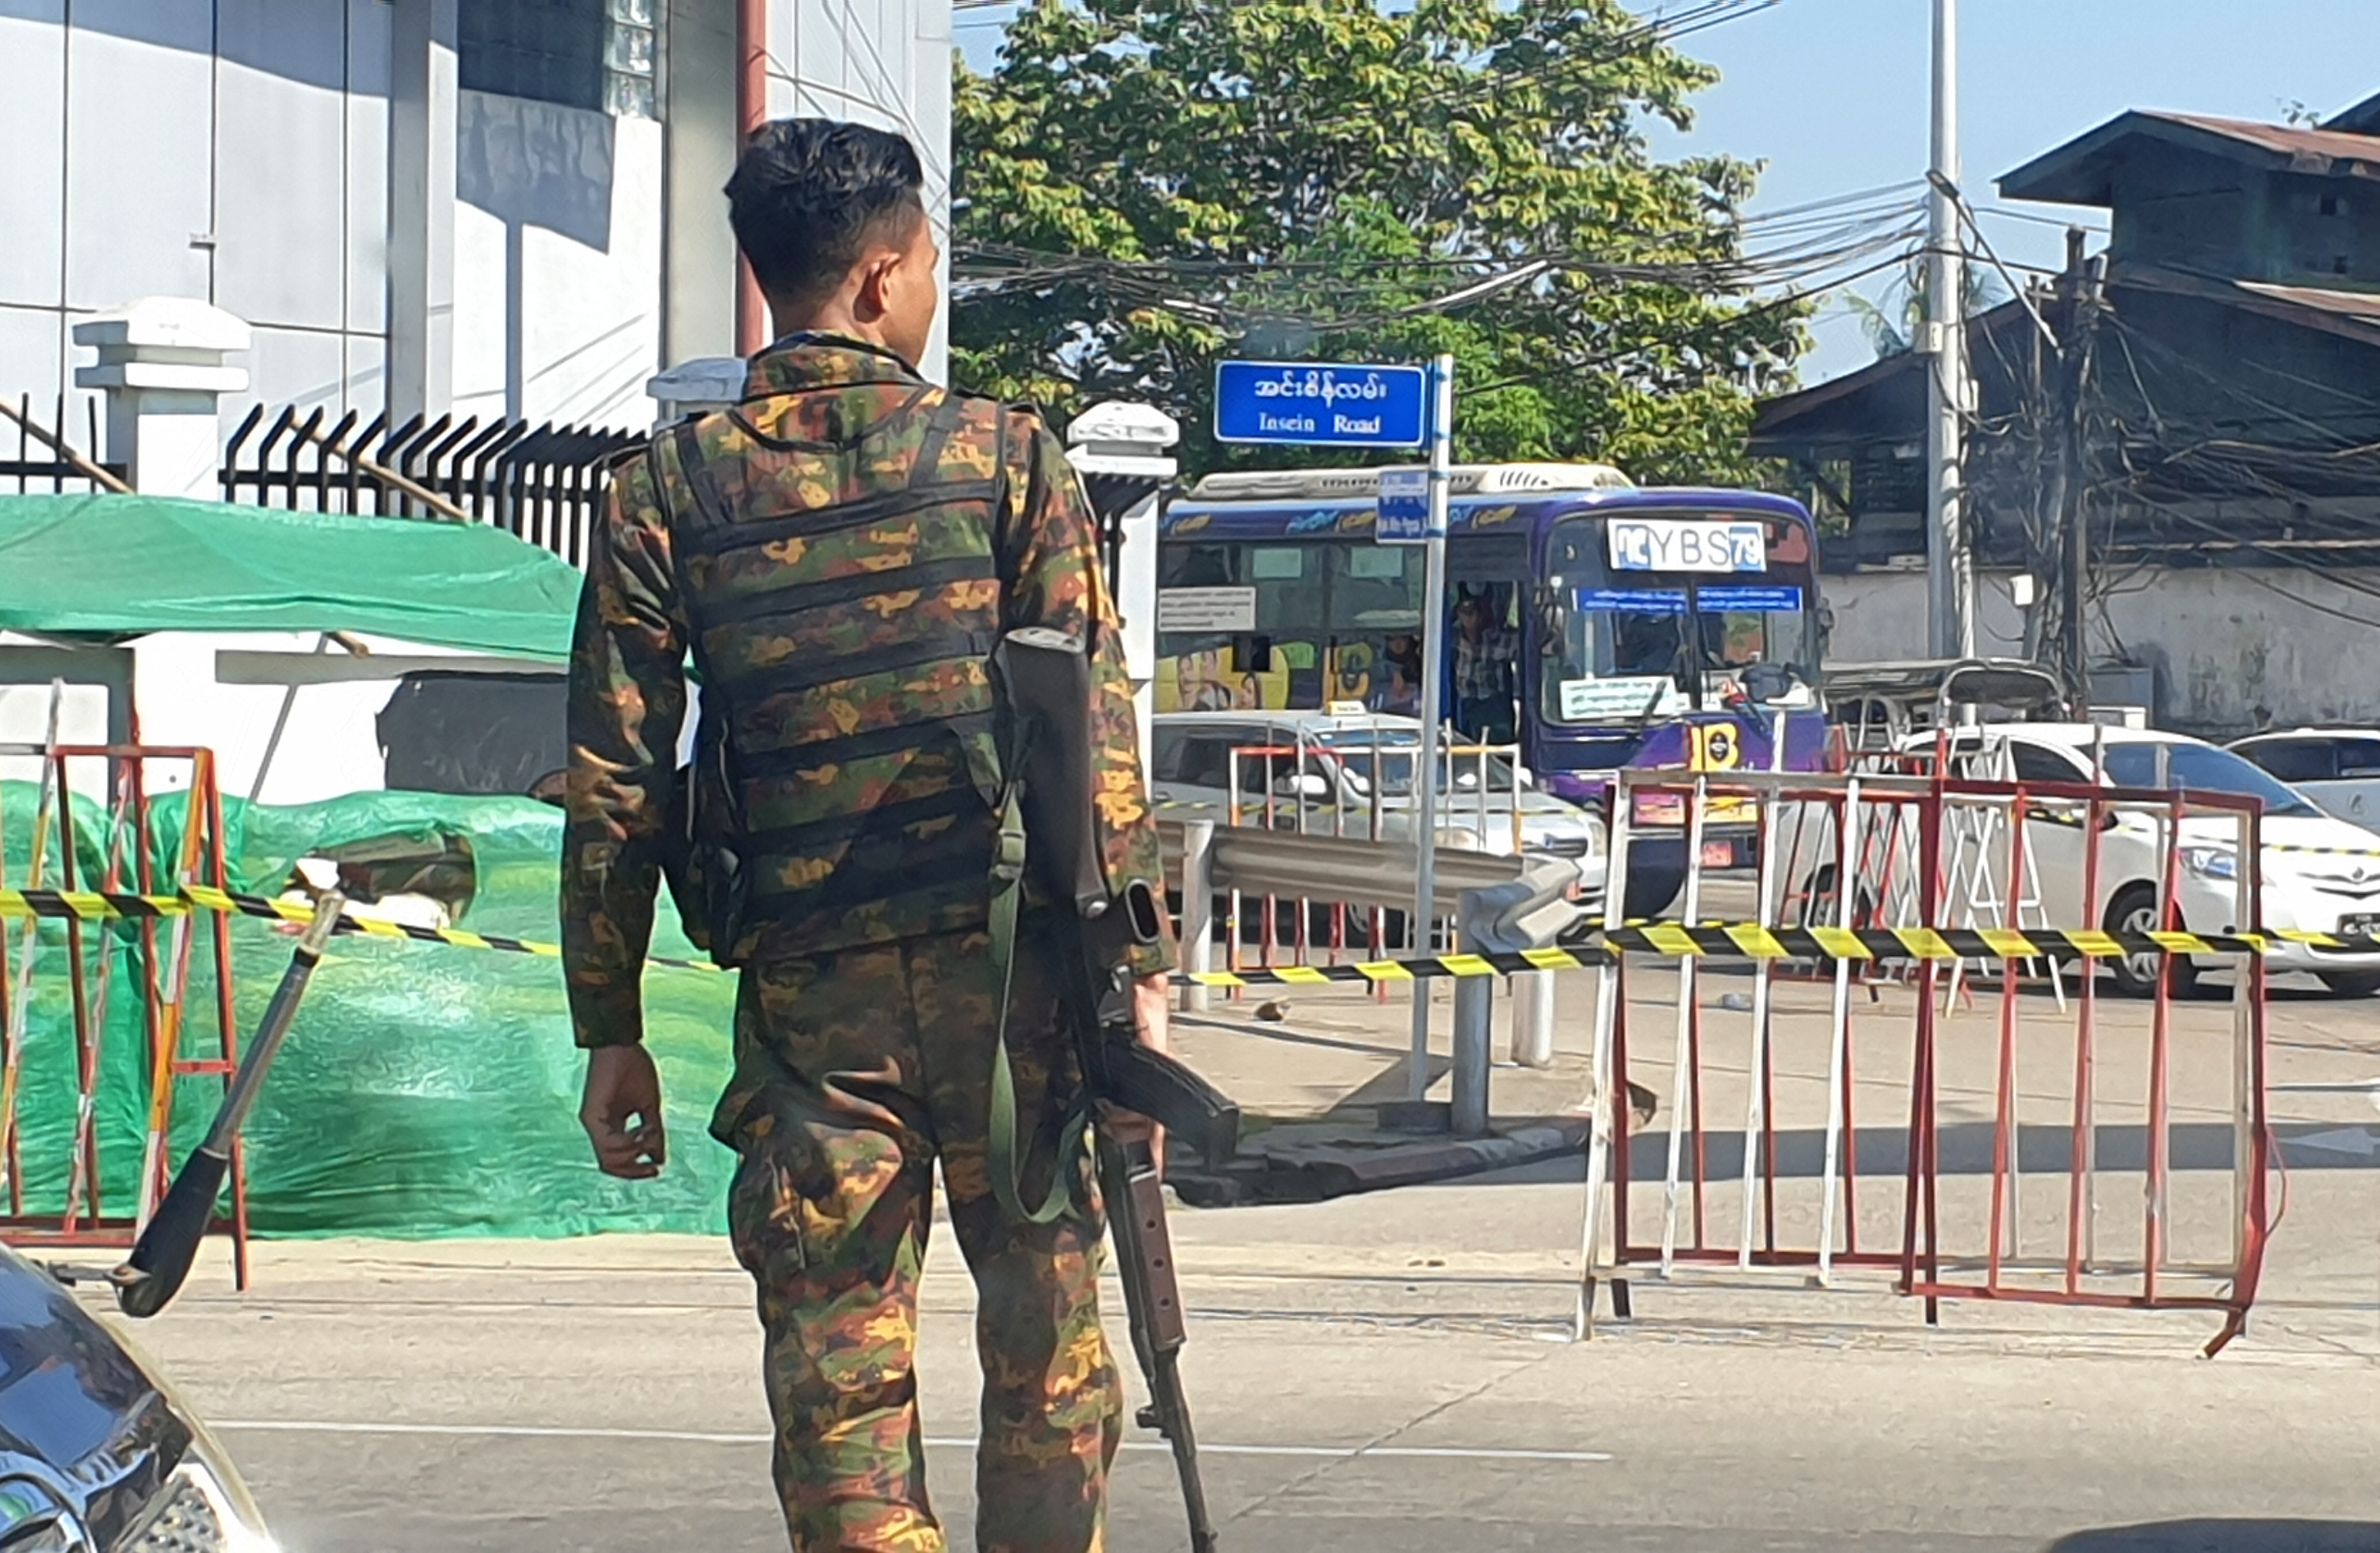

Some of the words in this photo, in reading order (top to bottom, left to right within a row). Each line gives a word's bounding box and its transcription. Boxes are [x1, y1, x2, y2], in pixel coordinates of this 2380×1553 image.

[1254, 370, 1386, 408] အင်းစိန်လမ်း
[1259, 412, 1315, 432] Insein
[1333, 414, 1381, 433] Road
[1650, 528, 1730, 566] YBS
[1730, 531, 1761, 567] 79
